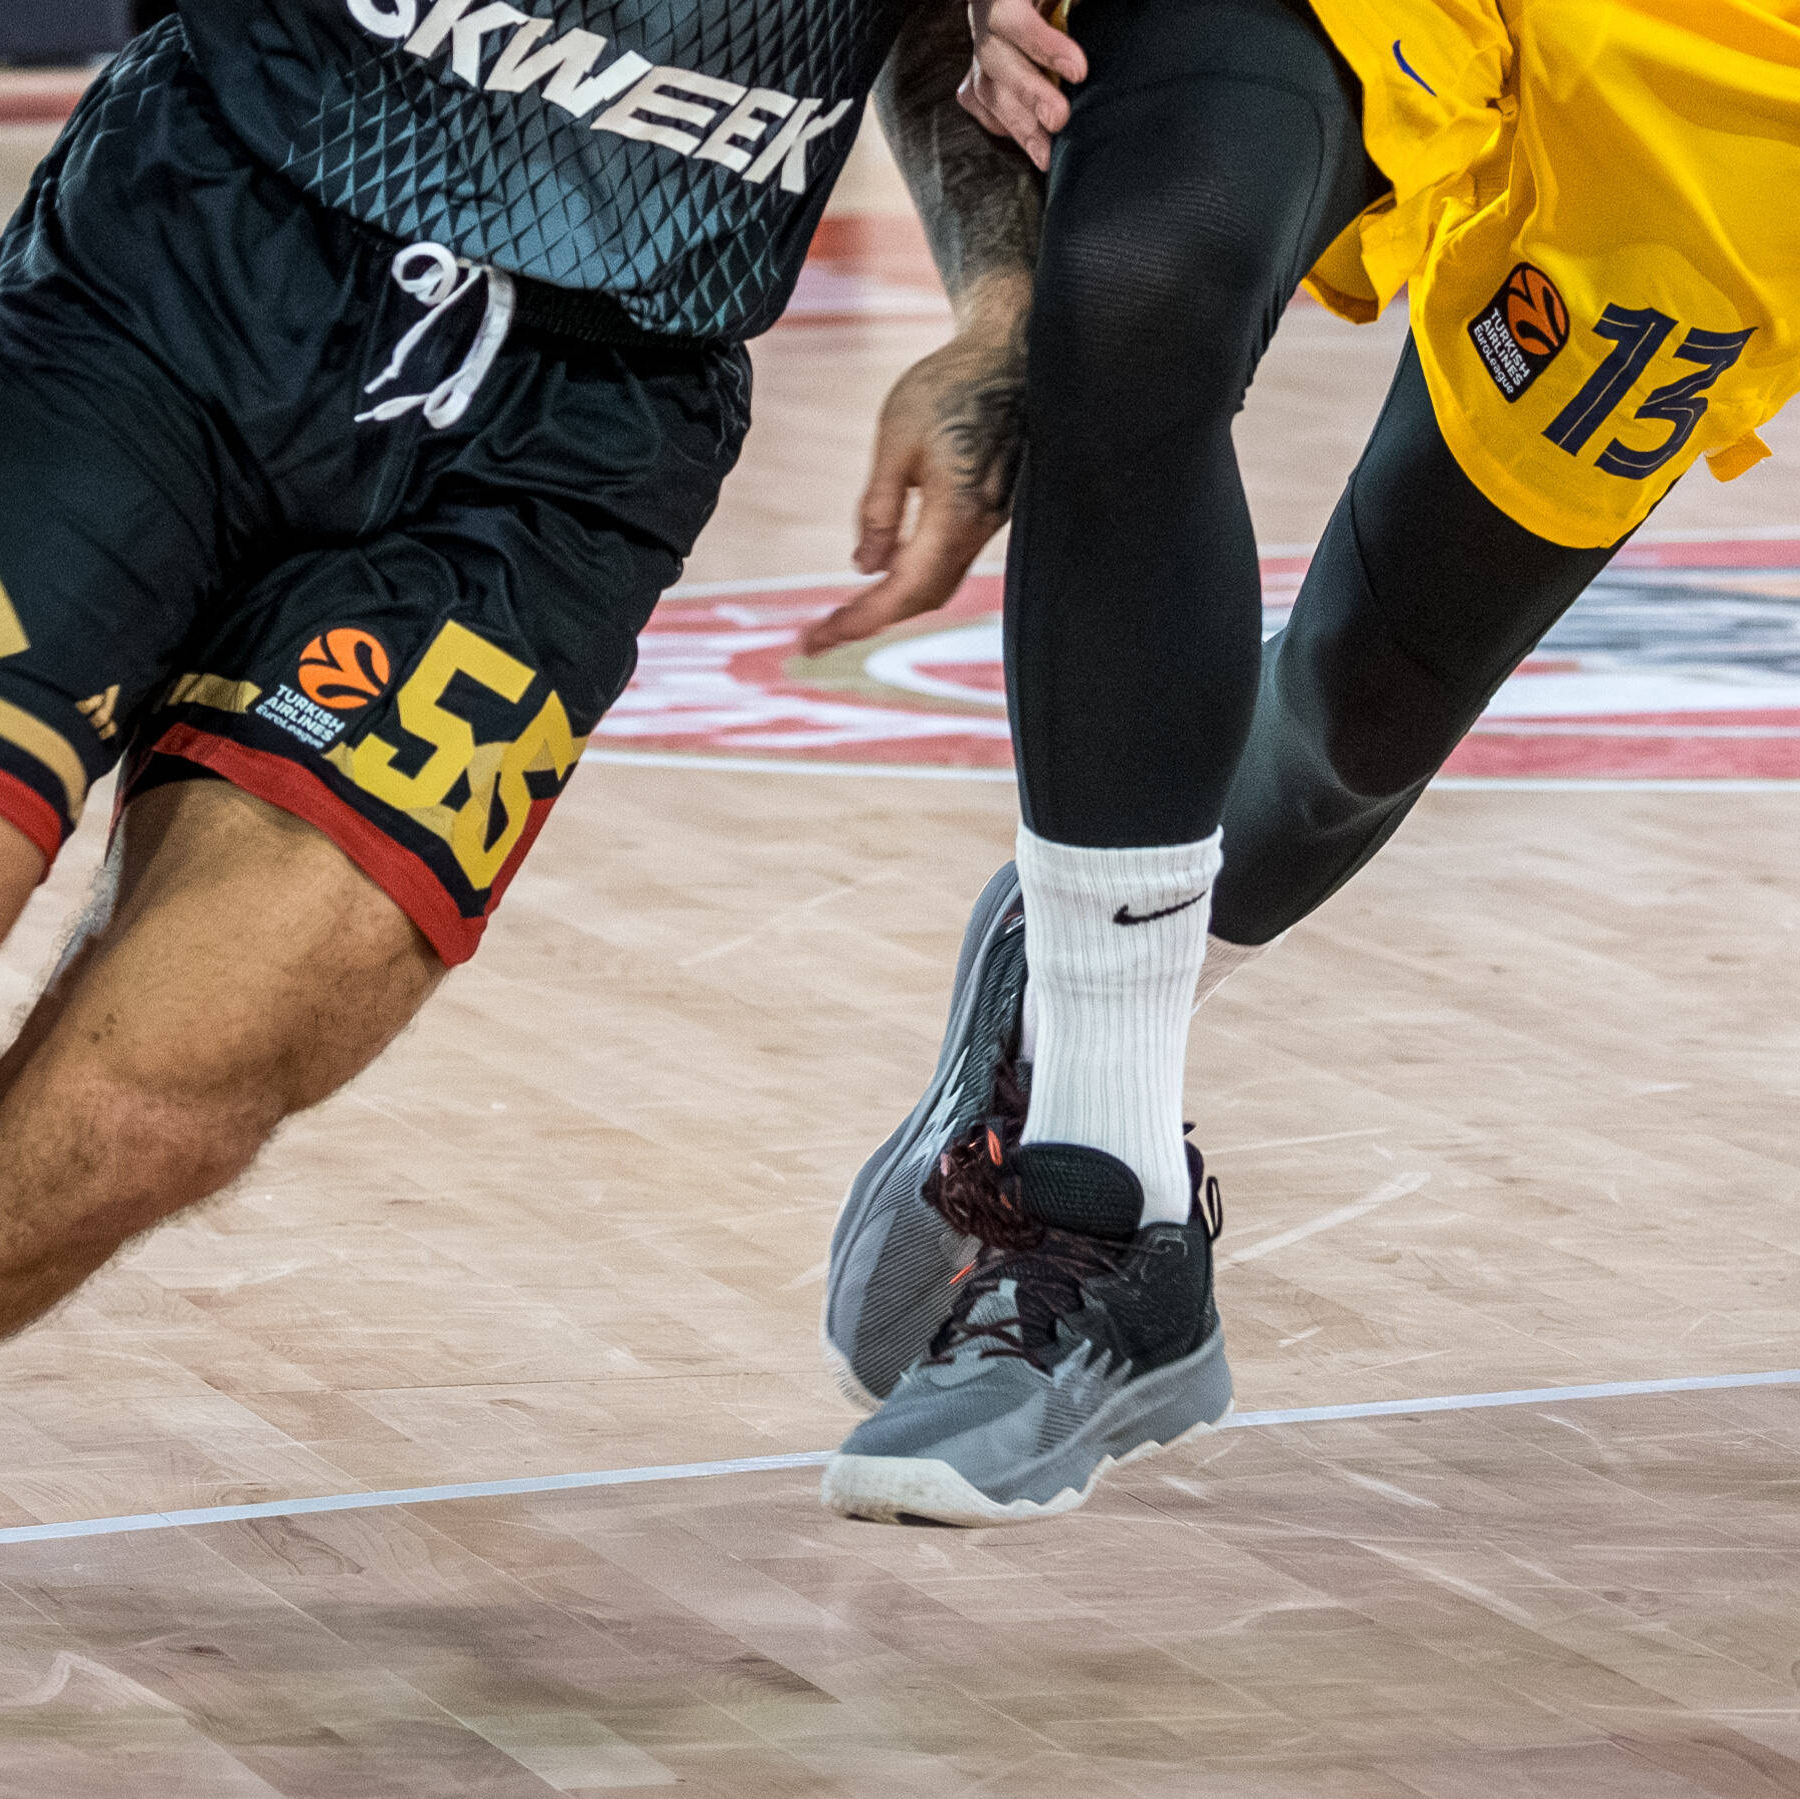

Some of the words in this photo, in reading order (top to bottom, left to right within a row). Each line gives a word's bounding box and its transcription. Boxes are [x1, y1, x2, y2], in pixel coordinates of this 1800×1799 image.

[1473, 324, 1514, 394] EuroLeague
[1482, 319, 1524, 386] AIRLINES
[1491, 307, 1531, 378] TURKISH
[1541, 302, 1759, 481] 13
[263, 696, 335, 742] AIRLINES
[276, 683, 346, 734] TURKISH
[351, 618, 574, 892] 55
